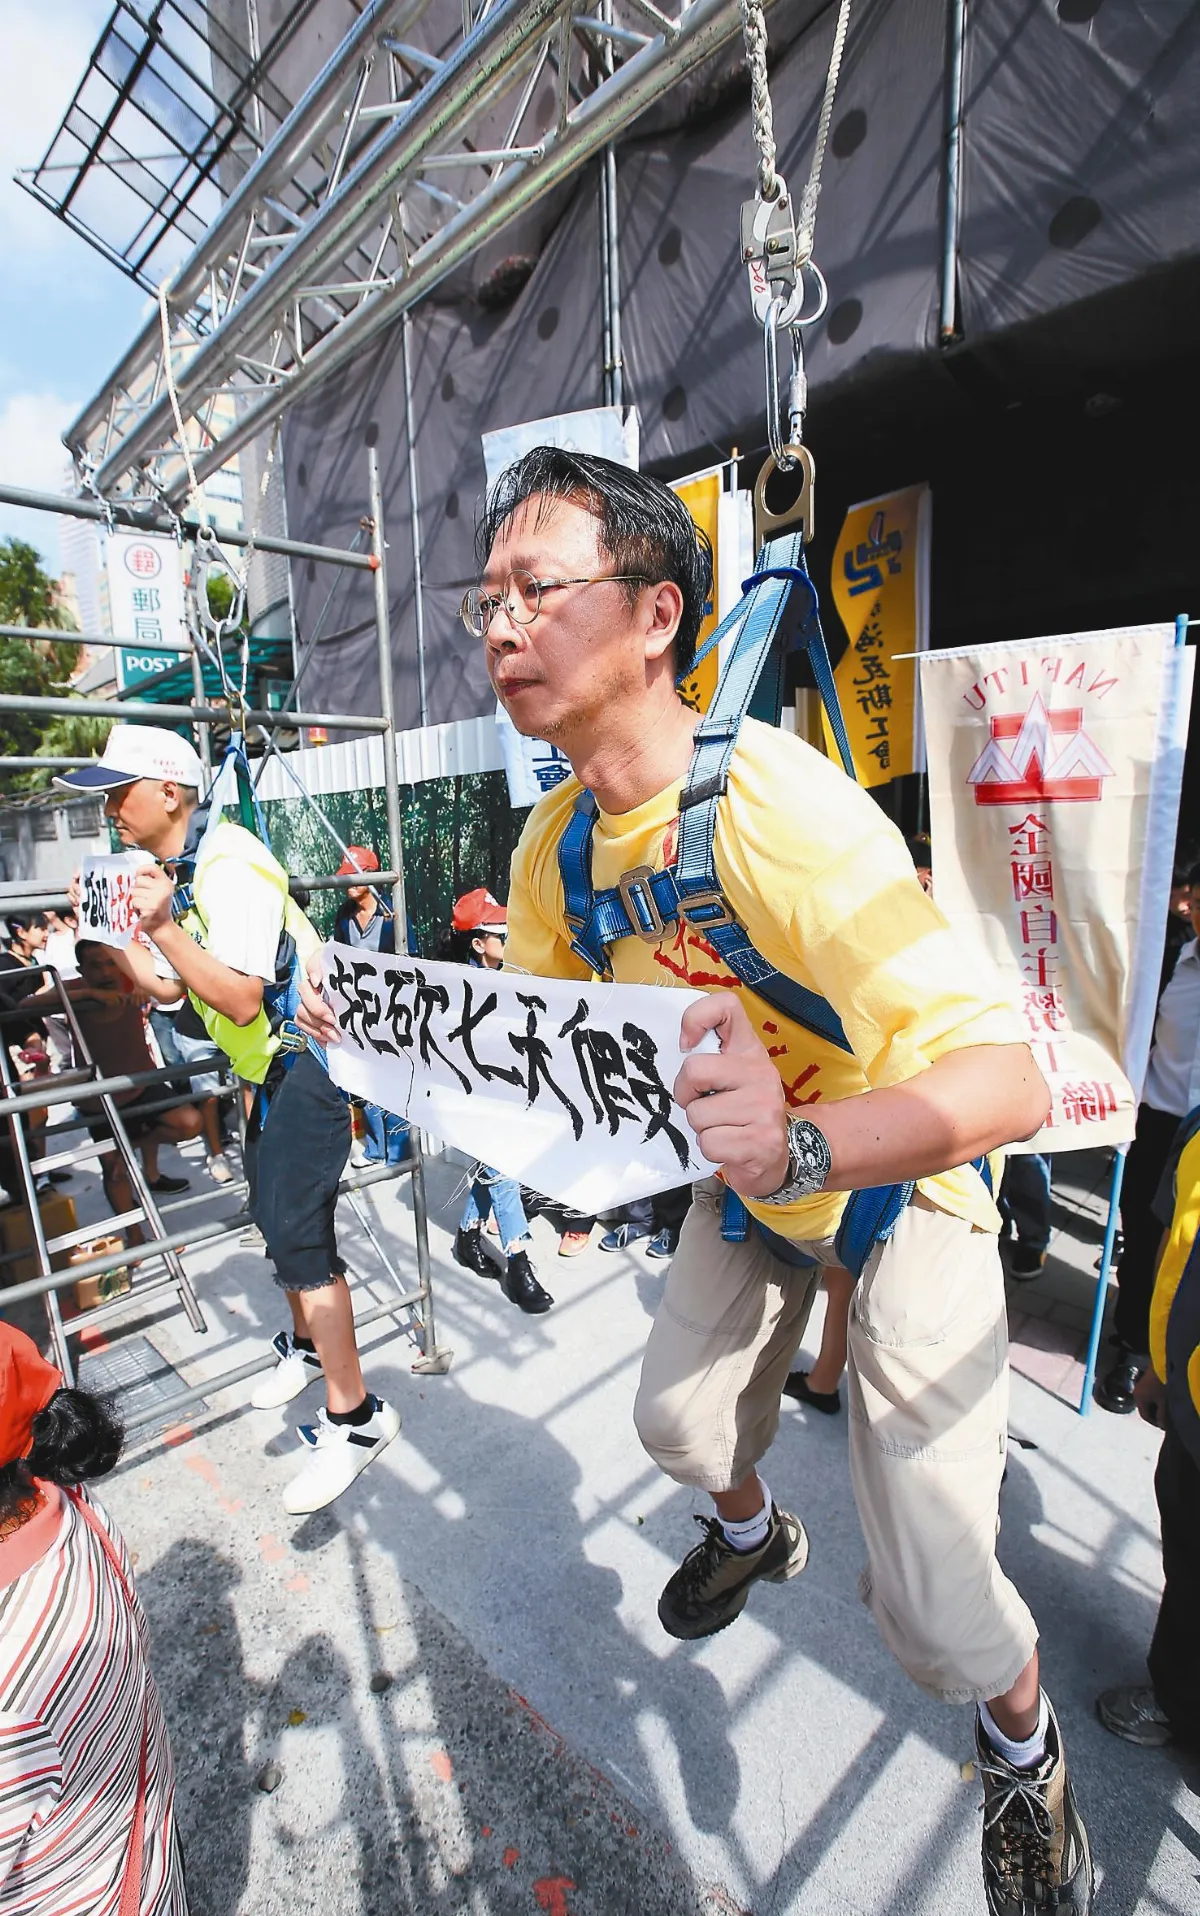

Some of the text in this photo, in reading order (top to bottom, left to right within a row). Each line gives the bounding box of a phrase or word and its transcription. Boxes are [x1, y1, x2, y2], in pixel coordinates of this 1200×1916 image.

[131, 587, 163, 643] 郵局
[125, 655, 175, 673] POST
[328, 954, 698, 1171] 拒砍七天假
